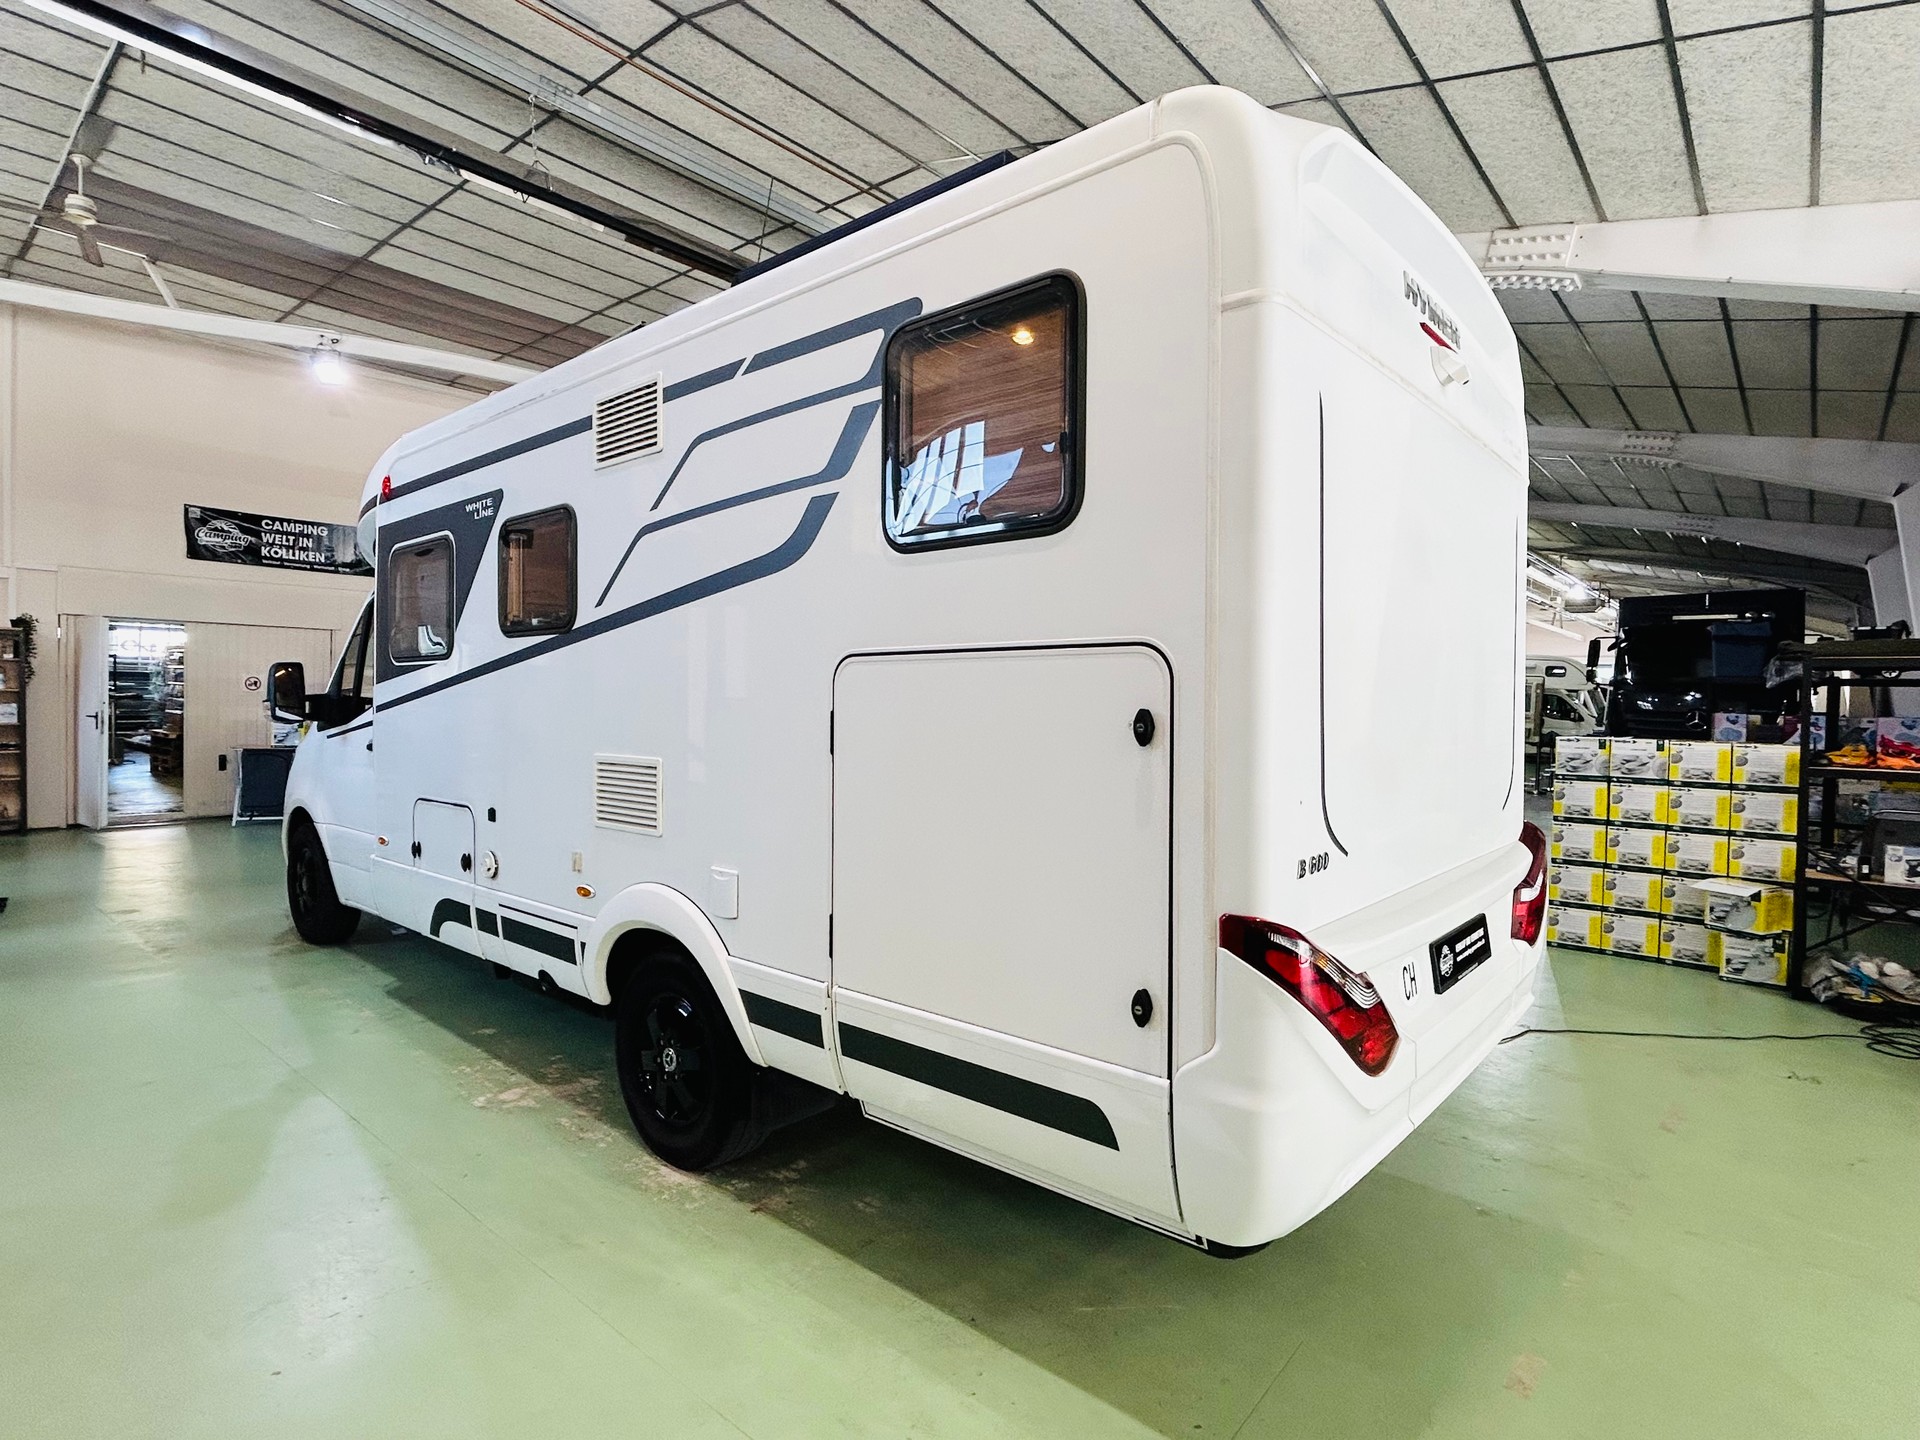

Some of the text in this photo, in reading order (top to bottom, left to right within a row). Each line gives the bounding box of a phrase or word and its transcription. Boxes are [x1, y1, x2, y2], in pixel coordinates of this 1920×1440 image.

[465, 497, 493, 512] WHITE
[474, 507, 494, 520] LINE
[195, 527, 251, 546] Camping
[261, 519, 329, 537] CAMPING
[261, 532, 313, 548] WELT IN
[261, 545, 325, 563] KÖLLIKEN
[1296, 859, 1307, 880] B
[1402, 961, 1418, 1001] CH
